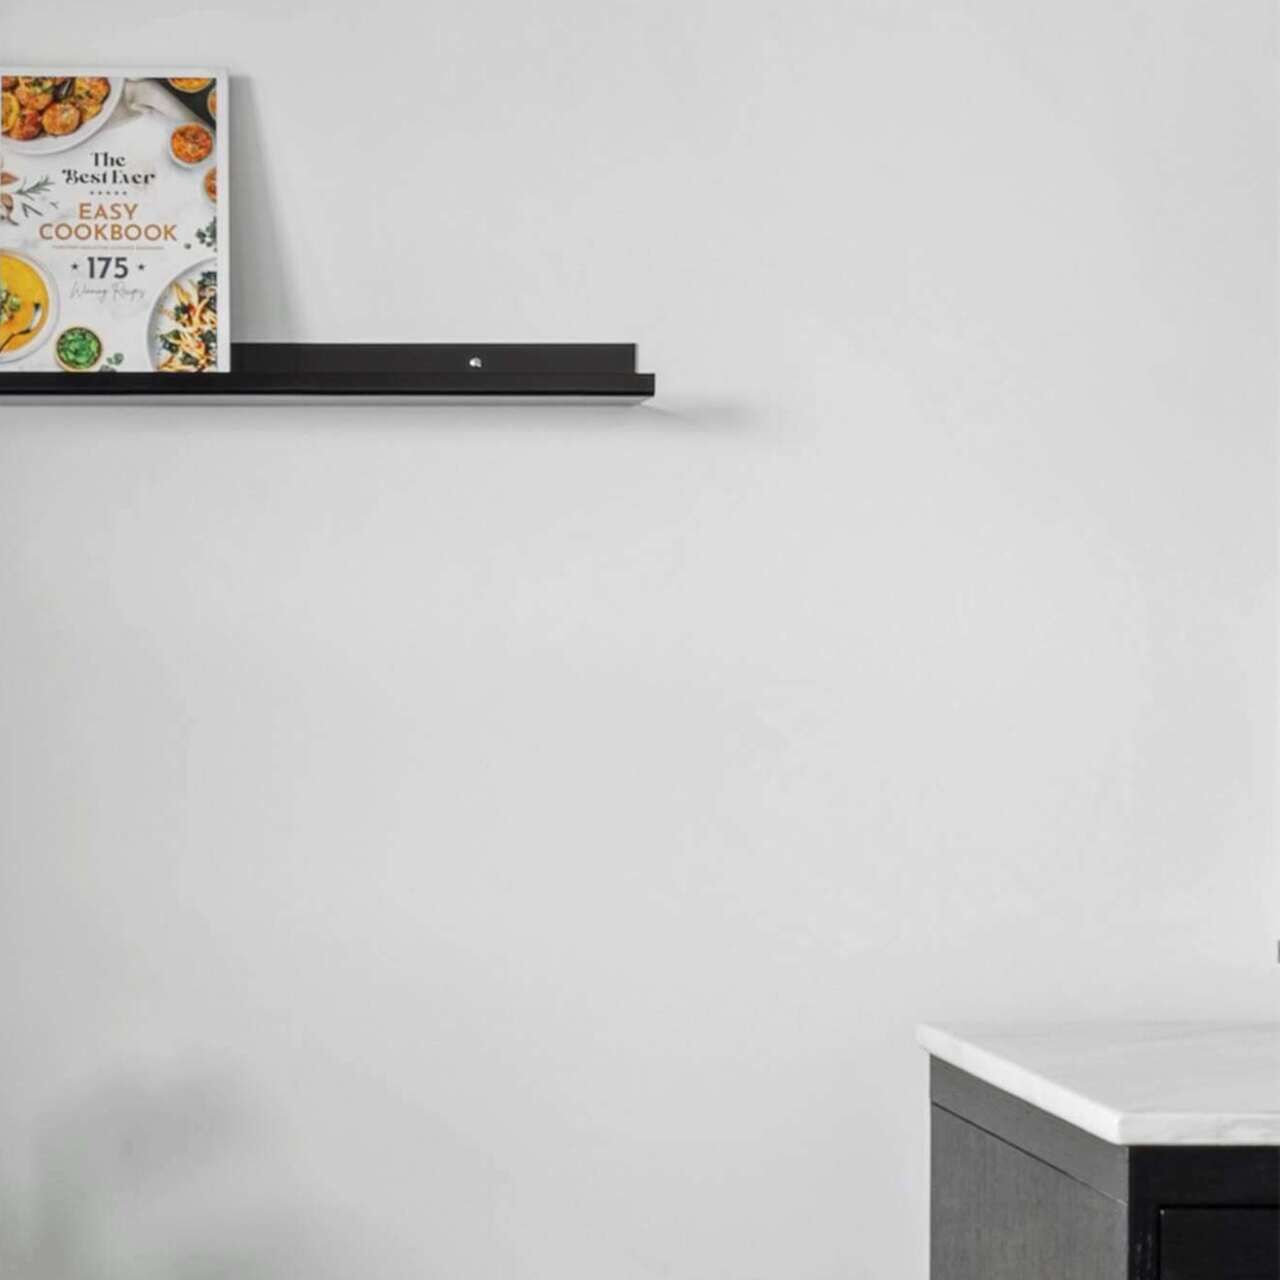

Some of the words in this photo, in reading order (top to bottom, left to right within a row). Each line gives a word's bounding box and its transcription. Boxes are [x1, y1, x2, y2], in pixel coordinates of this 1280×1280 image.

[91, 152, 126, 167] The
[61, 169, 108, 185] Best
[111, 169, 156, 185] Ever
[79, 203, 138, 220] EASY
[39, 223, 177, 241] COOKBOOK
[87, 256, 129, 279] 175
